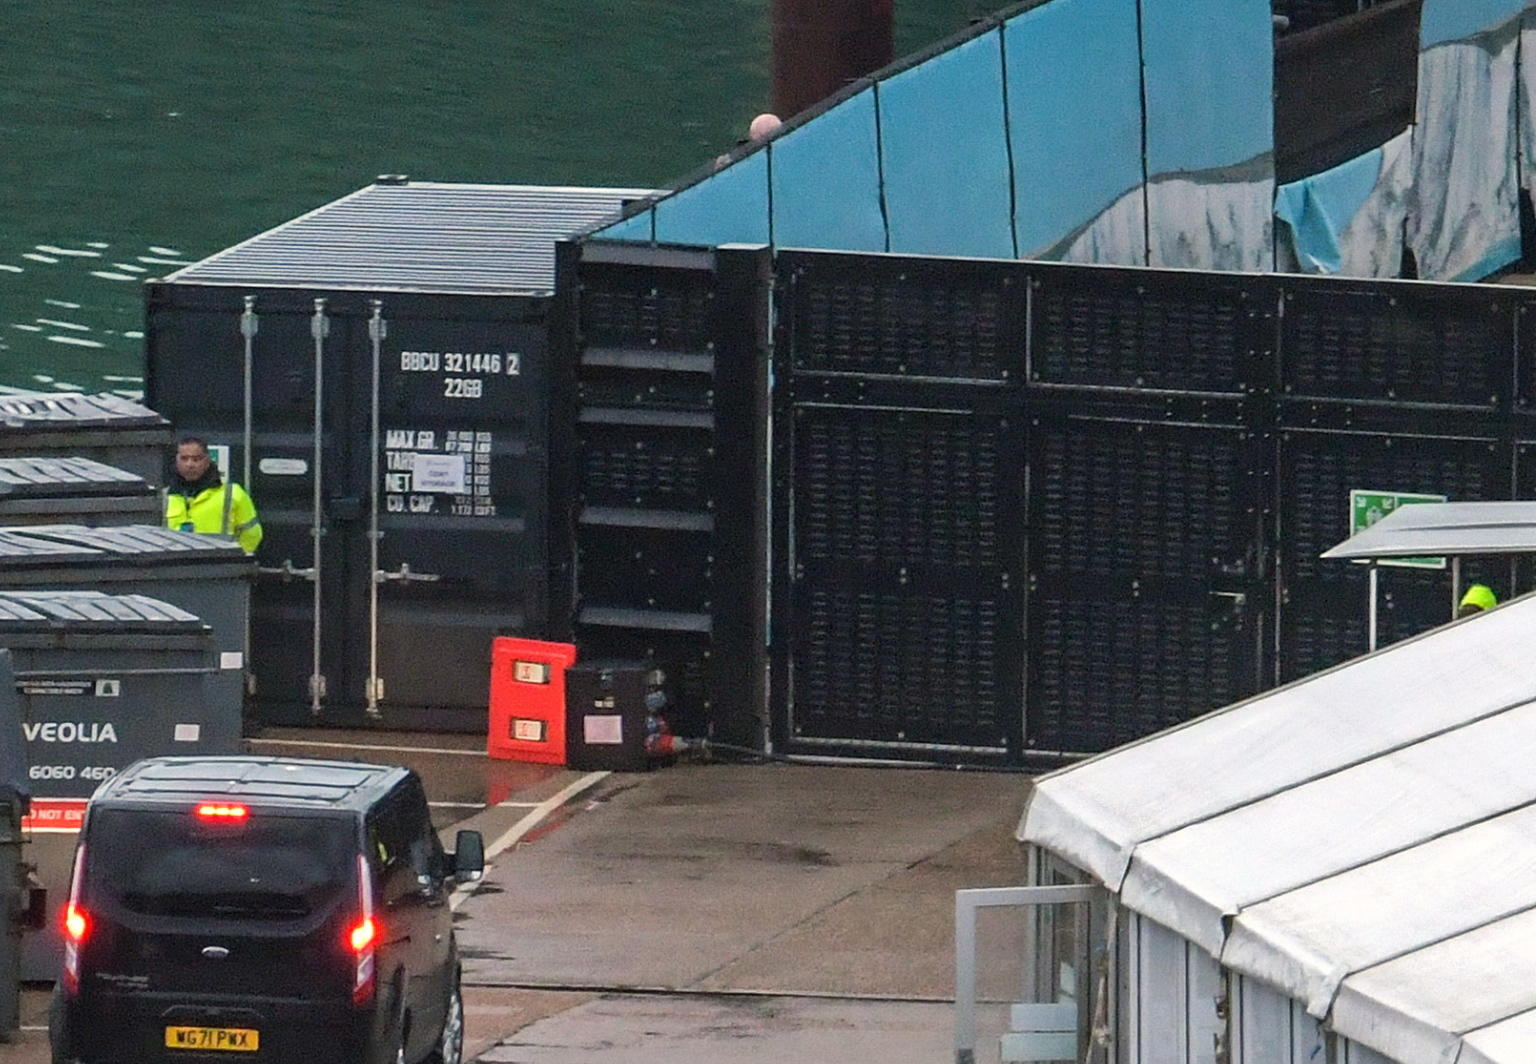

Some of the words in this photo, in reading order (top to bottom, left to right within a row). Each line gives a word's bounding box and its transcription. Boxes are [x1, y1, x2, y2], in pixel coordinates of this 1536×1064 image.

[401, 352, 439, 371] BBCU
[444, 353, 501, 373] 321446
[506, 353, 520, 375] 2
[22, 722, 117, 742] VEOLIA
[29, 766, 75, 780] 6060
[38, 809, 62, 820] NOT
[176, 1030, 212, 1046] WG71
[217, 1031, 249, 1047] PWX
